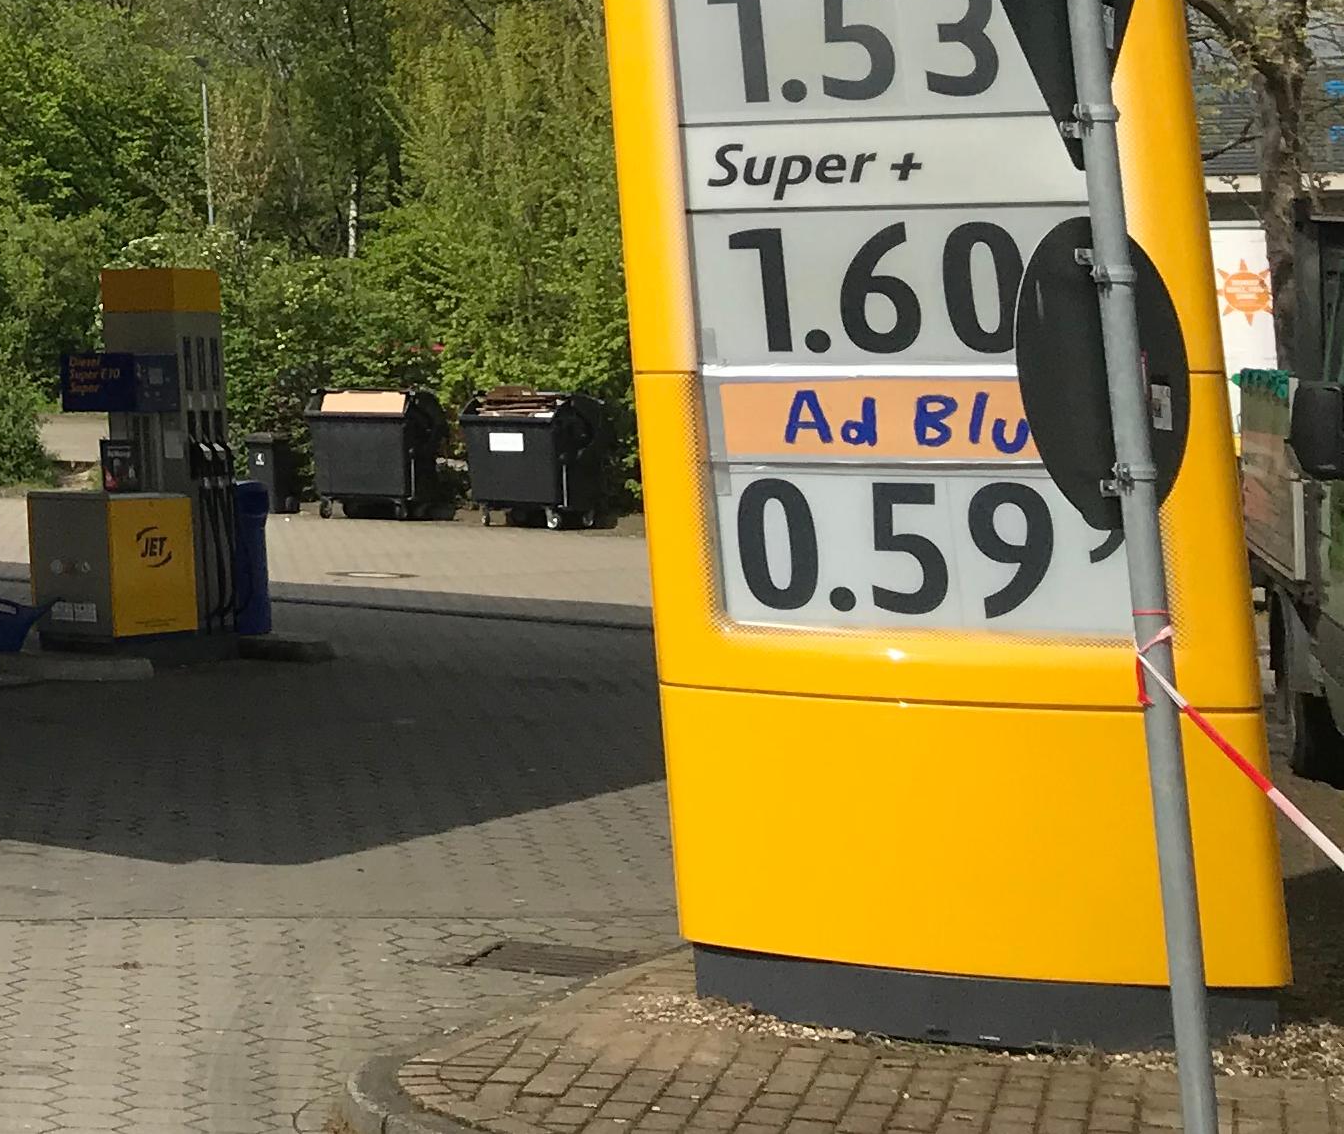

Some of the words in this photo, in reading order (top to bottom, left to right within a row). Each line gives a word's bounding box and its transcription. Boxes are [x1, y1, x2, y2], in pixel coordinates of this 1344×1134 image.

[707, 143, 877, 200] Super
[728, 221, 1024, 354] 1.60
[784, 389, 878, 447] Ad
[141, 536, 168, 558] JET
